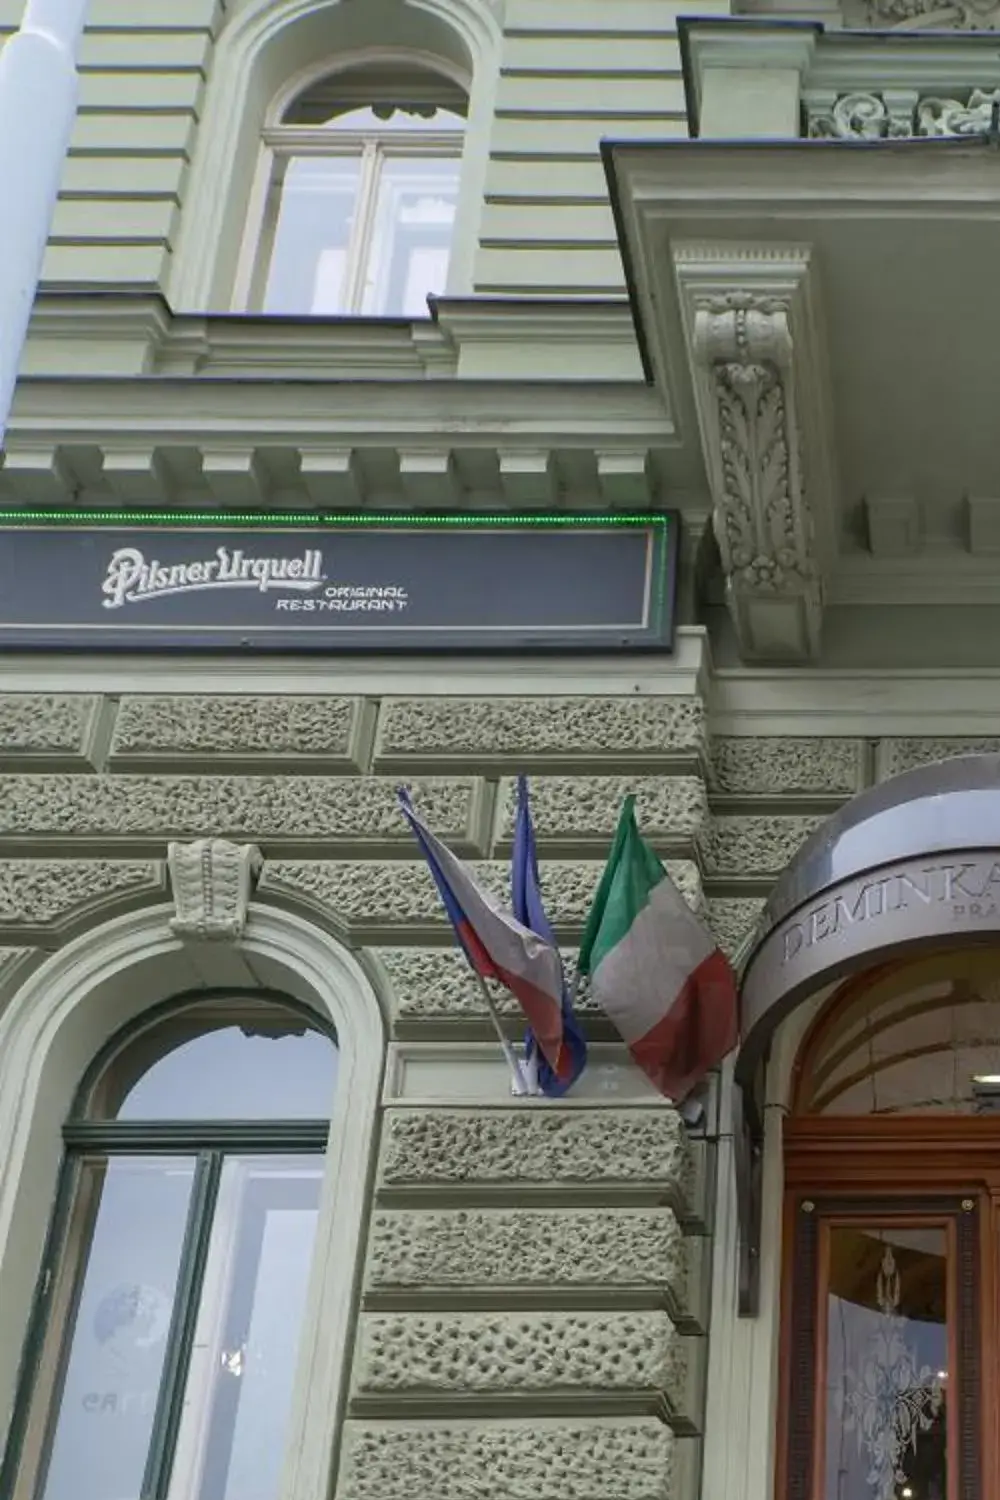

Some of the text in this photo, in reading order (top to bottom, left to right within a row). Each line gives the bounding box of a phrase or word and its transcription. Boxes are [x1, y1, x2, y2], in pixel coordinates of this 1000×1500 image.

[102, 546, 323, 608] Pilsner Urquell
[325, 587, 407, 599] ORIGINAL
[276, 600, 407, 612] RESTAURANT
